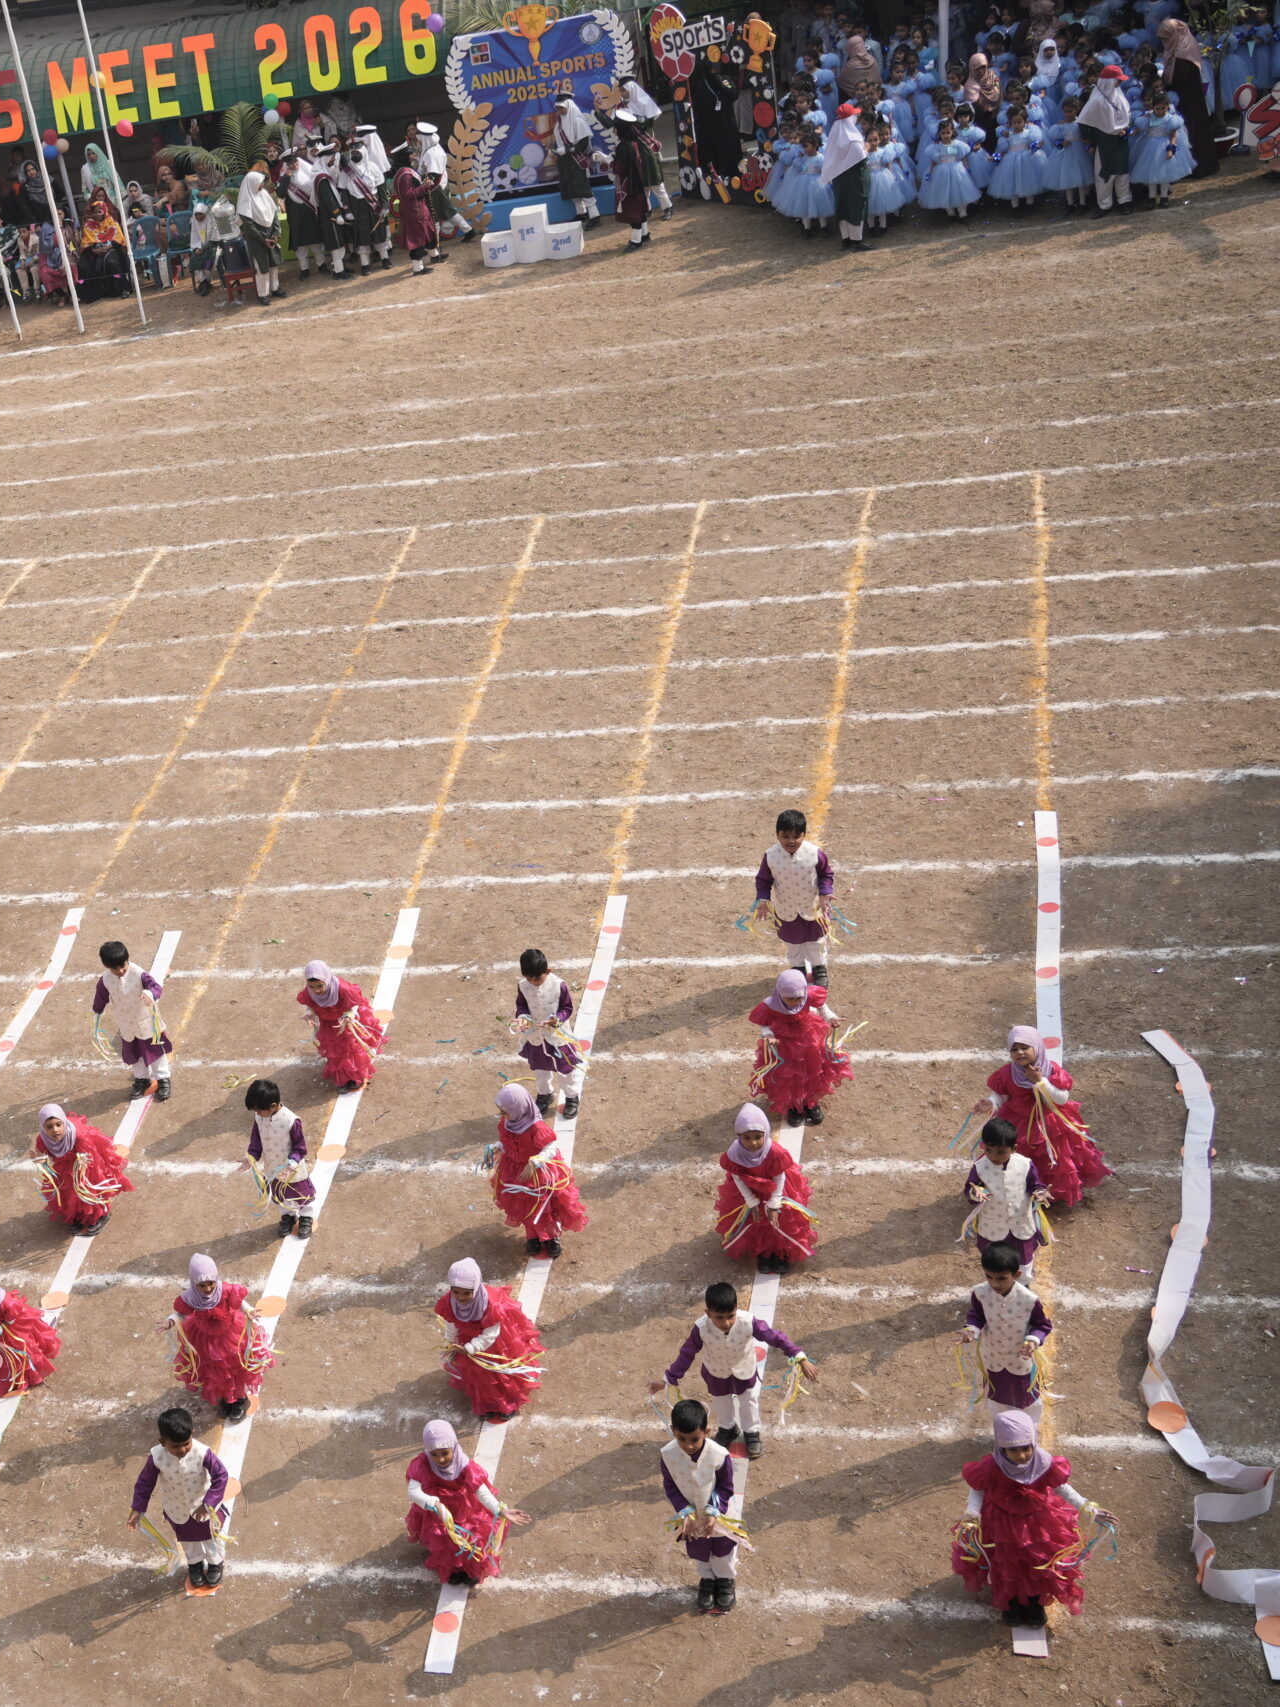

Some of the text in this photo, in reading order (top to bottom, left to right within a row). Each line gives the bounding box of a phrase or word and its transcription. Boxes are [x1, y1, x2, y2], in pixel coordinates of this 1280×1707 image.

[662, 18, 723, 57] sports
[47, 33, 215, 134] MEET
[254, 0, 437, 101] 2026
[471, 52, 607, 91] ANNUAL SPORTS
[518, 226, 535, 241] 1st
[552, 235, 571, 250] 2nd
[489, 244, 508, 260] 3rd
